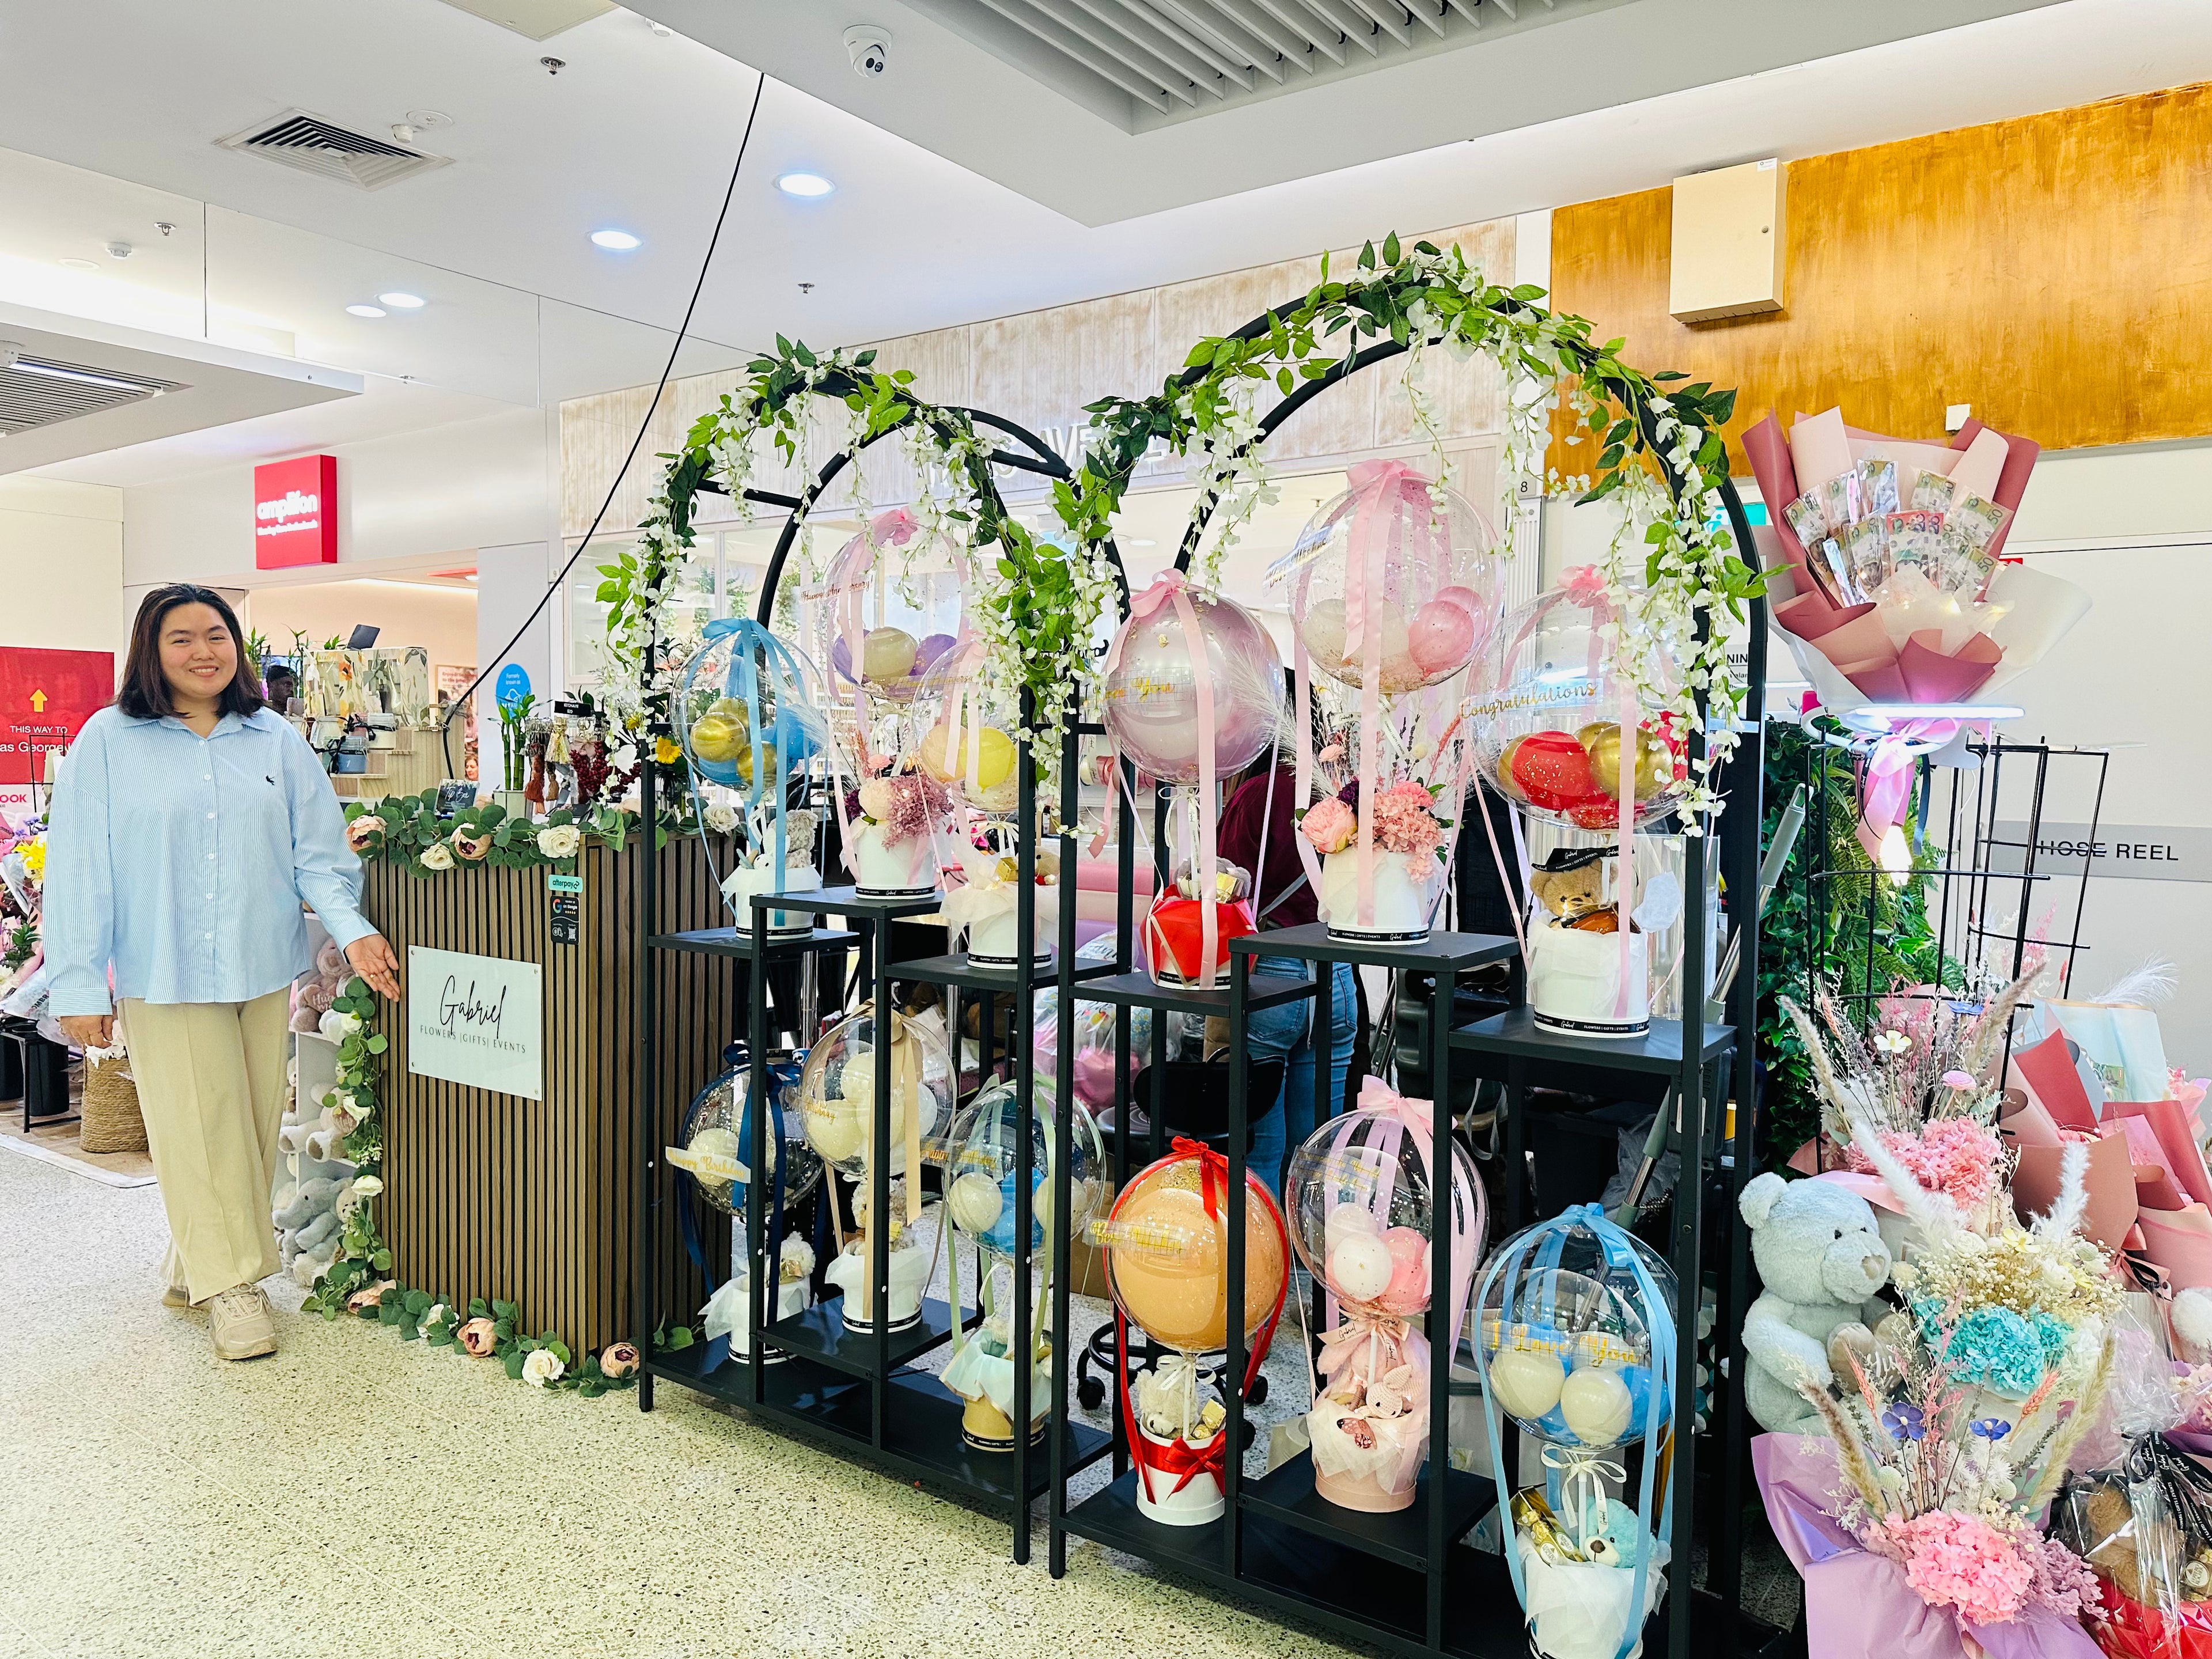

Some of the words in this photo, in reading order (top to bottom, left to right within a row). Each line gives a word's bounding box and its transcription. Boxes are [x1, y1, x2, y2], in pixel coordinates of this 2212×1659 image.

[1521, 482, 1527, 492] 8
[1929, 516, 1940, 534] 20
[1987, 509, 2003, 525] 50
[1979, 557, 1994, 573] 50
[1460, 682, 1599, 720] Congratulations
[10, 725, 31, 733] THIS
[55, 726, 68, 734] TO
[0, 743, 14, 752] as
[0, 794, 27, 803] OOK
[2040, 840, 2106, 858] HOSE
[2116, 843, 2179, 861] REEL
[552, 878, 574, 889] afterpay
[440, 975, 506, 1039] Gabriel
[419, 1024, 456, 1040] FLOWERS
[493, 1039, 526, 1054] EVENTS
[699, 1156, 745, 1180] Birthday
[1338, 1323, 1357, 1339] Gabriel
[1490, 1321, 1501, 1351] I
[1509, 1324, 1575, 1355] Love
[1578, 1335, 1642, 1368] You
